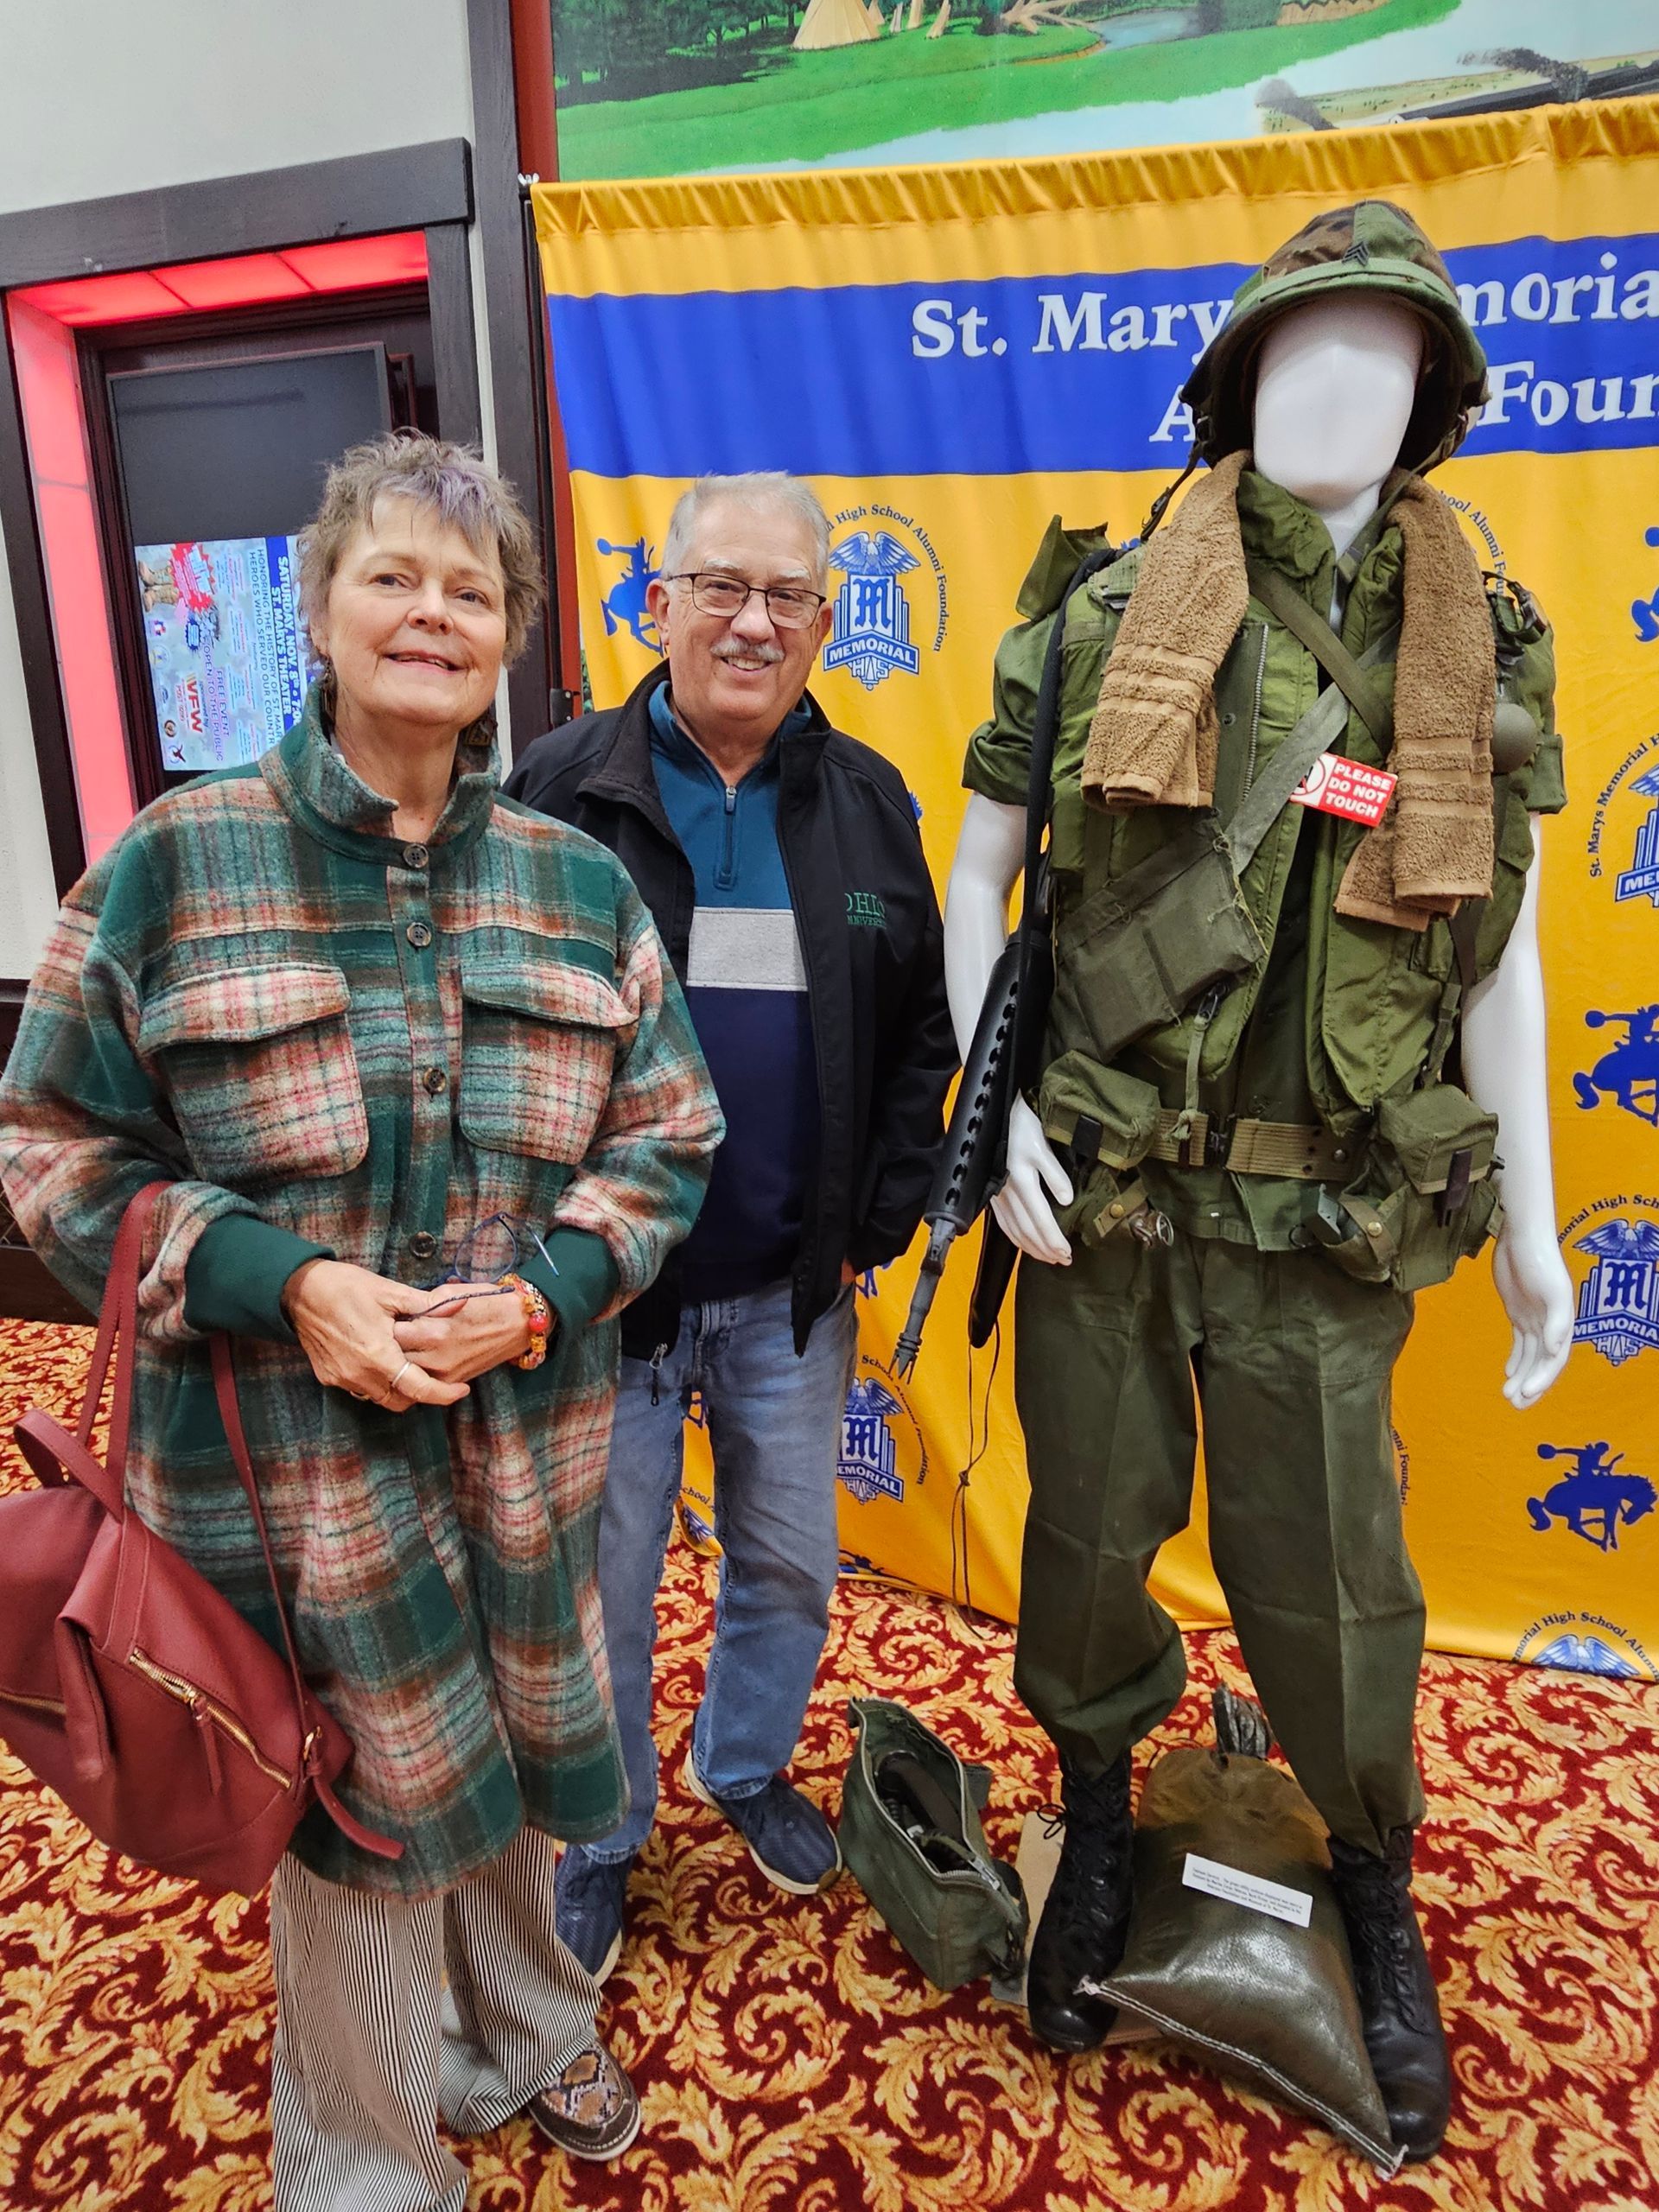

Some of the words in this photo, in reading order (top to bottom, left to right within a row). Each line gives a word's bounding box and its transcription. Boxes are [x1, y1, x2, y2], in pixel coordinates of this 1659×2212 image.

[912, 300, 1007, 358] St.
[1469, 511, 1504, 559] Alumni
[249, 552, 260, 596] HEROES
[257, 549, 270, 608] HONORING
[835, 505, 868, 524] High
[871, 504, 914, 528] School
[912, 526, 944, 573] Alumni
[933, 574, 950, 653] Foundation
[254, 599, 263, 626] WHO
[271, 586, 282, 607] ST.
[274, 607, 286, 655] MARYS
[203, 645, 213, 676] OPEN
[257, 628, 268, 671] SERVED
[266, 633, 276, 678] HISTORY
[285, 635, 298, 669] NOV.
[830, 638, 914, 665] MEMORIAL
[207, 680, 215, 695] TO
[215, 670, 226, 699] FREE
[262, 673, 270, 696] OUR
[270, 681, 278, 695] OF
[278, 656, 291, 715] THEATER
[187, 681, 203, 734] VFW
[210, 698, 219, 719] THE
[219, 702, 230, 737] EVENT
[265, 700, 276, 744] COUNTR
[212, 722, 223, 761] PUBLIC
[1327, 776, 1351, 792] DO
[1353, 785, 1388, 804] NOT
[1334, 763, 1392, 791] PLEASE
[1597, 742, 1649, 807] Memorial
[1325, 792, 1379, 818] TOUCH
[1587, 810, 1605, 854] Marys
[1590, 858, 1602, 878] St.
[1592, 1194, 1627, 1212] High
[1541, 1611, 1575, 1627] High
[1580, 1611, 1627, 1637] School
